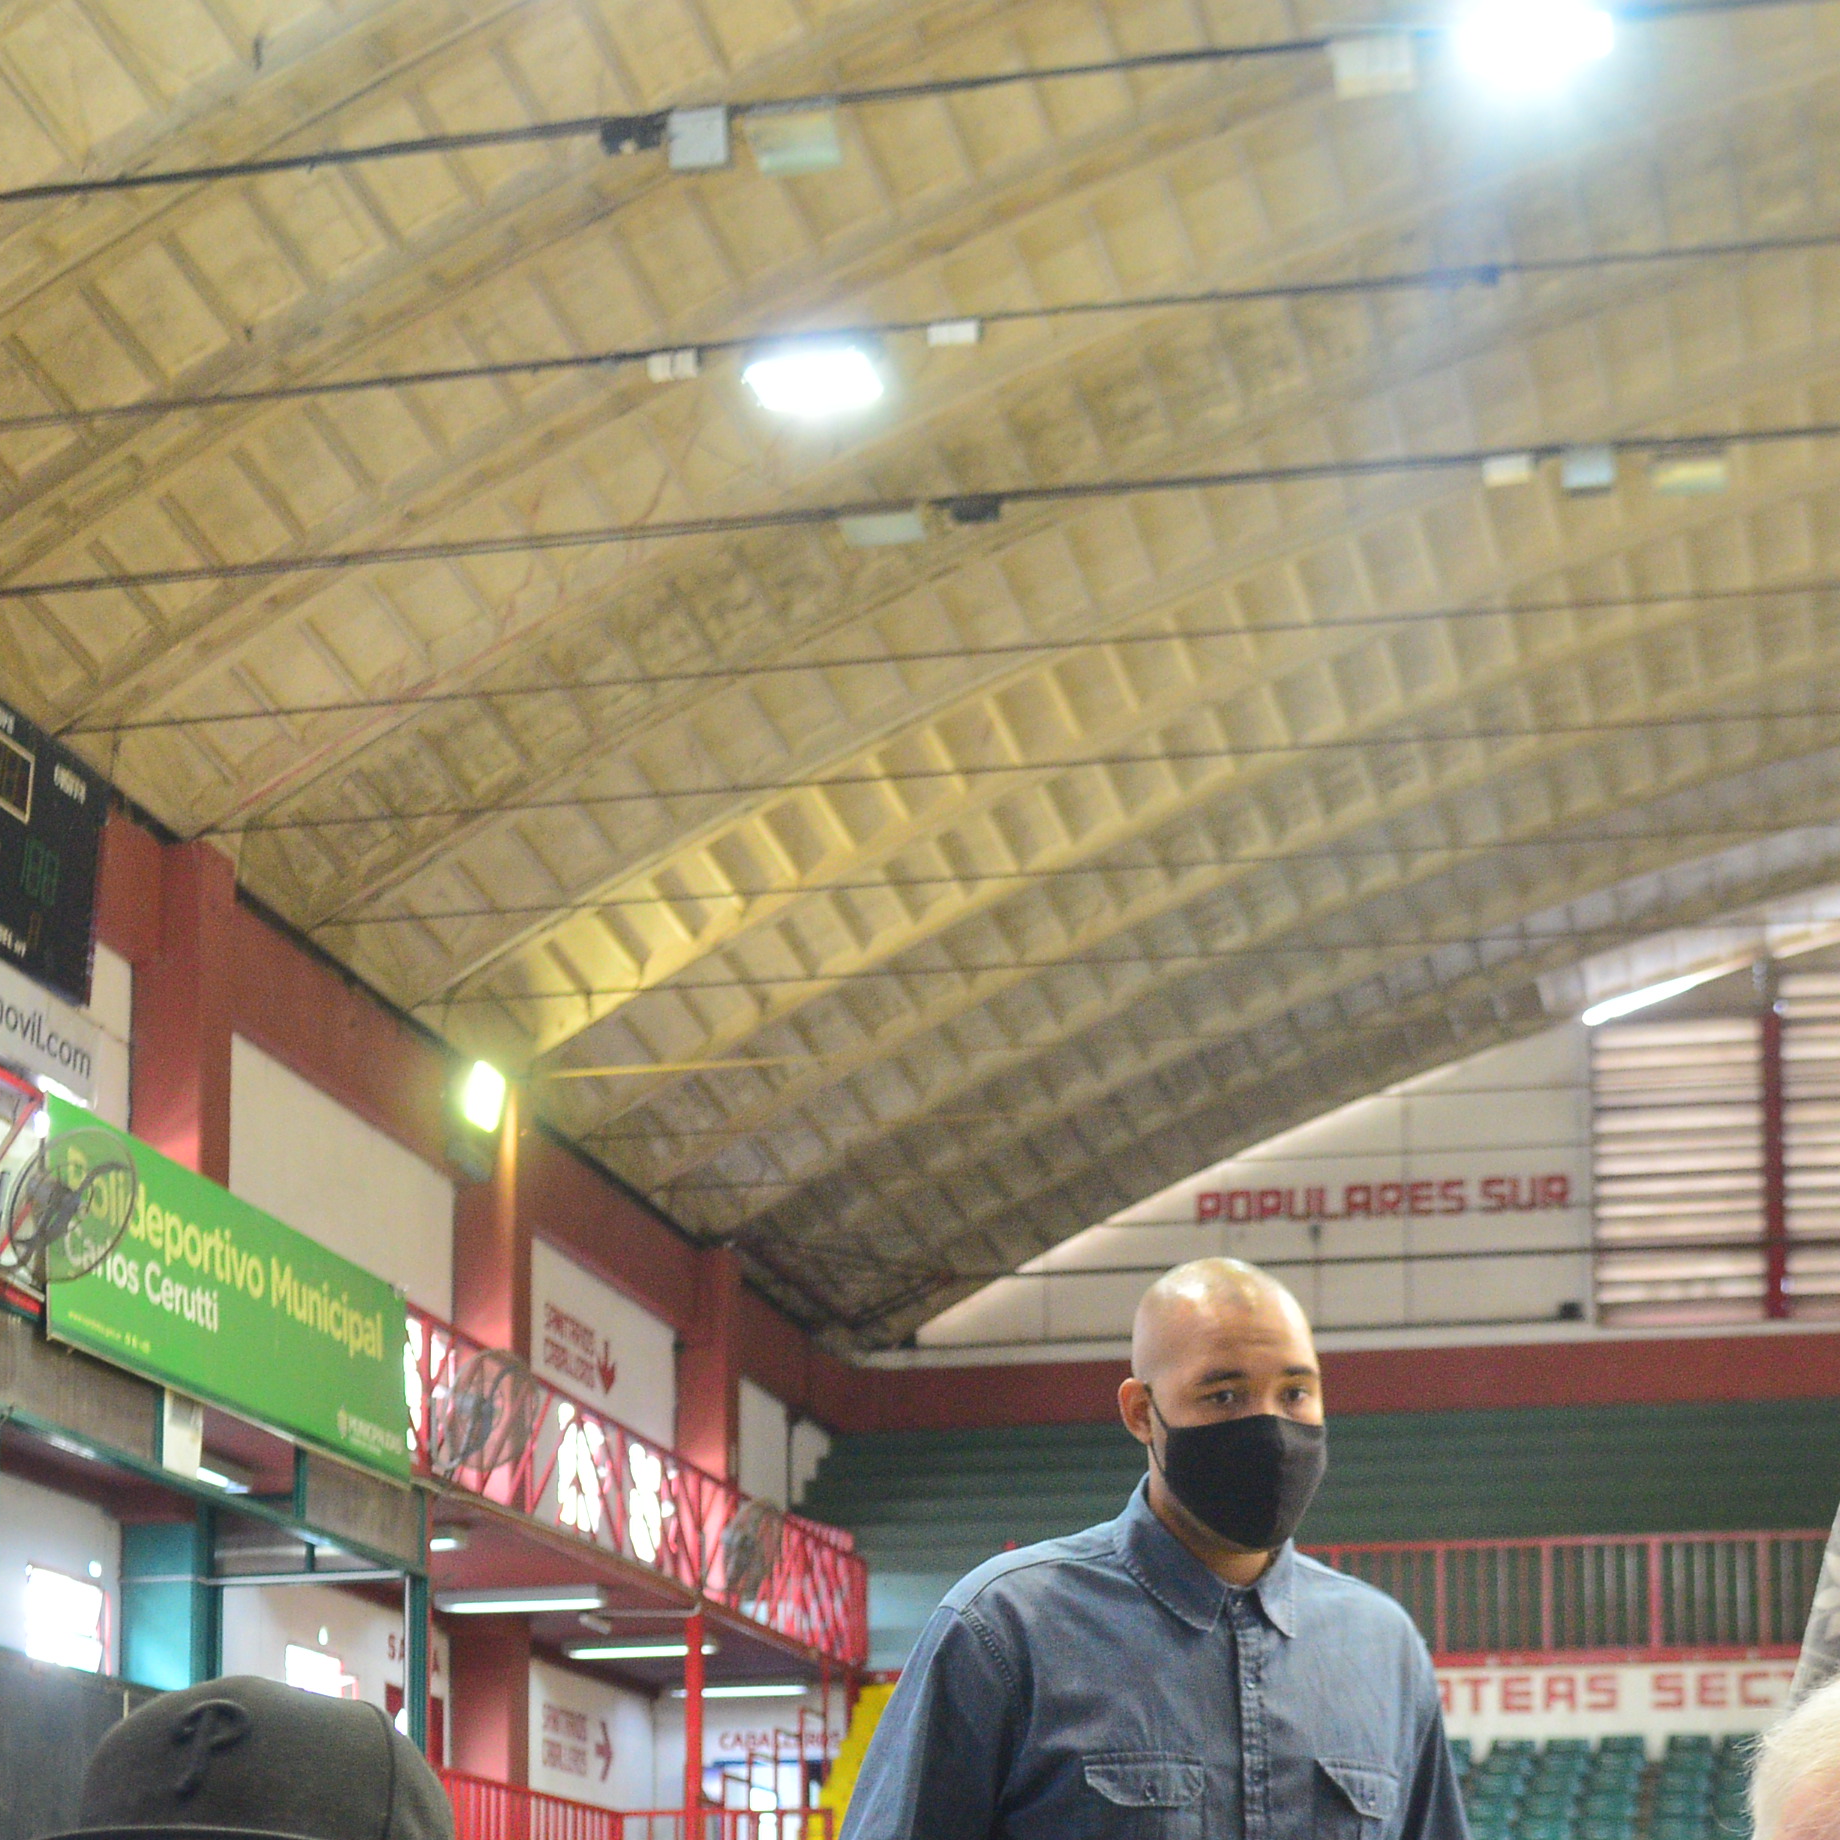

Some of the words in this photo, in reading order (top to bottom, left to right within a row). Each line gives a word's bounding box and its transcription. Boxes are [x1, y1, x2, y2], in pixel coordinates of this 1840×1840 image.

[66, 1145, 266, 1298] Polideportivo
[271, 1256, 384, 1362] Municipal
[1196, 1178, 1464, 1225] POPULARES
[1479, 1174, 1569, 1213] SUR
[64, 1219, 140, 1296] Carlos
[143, 1260, 219, 1334] Cerutti
